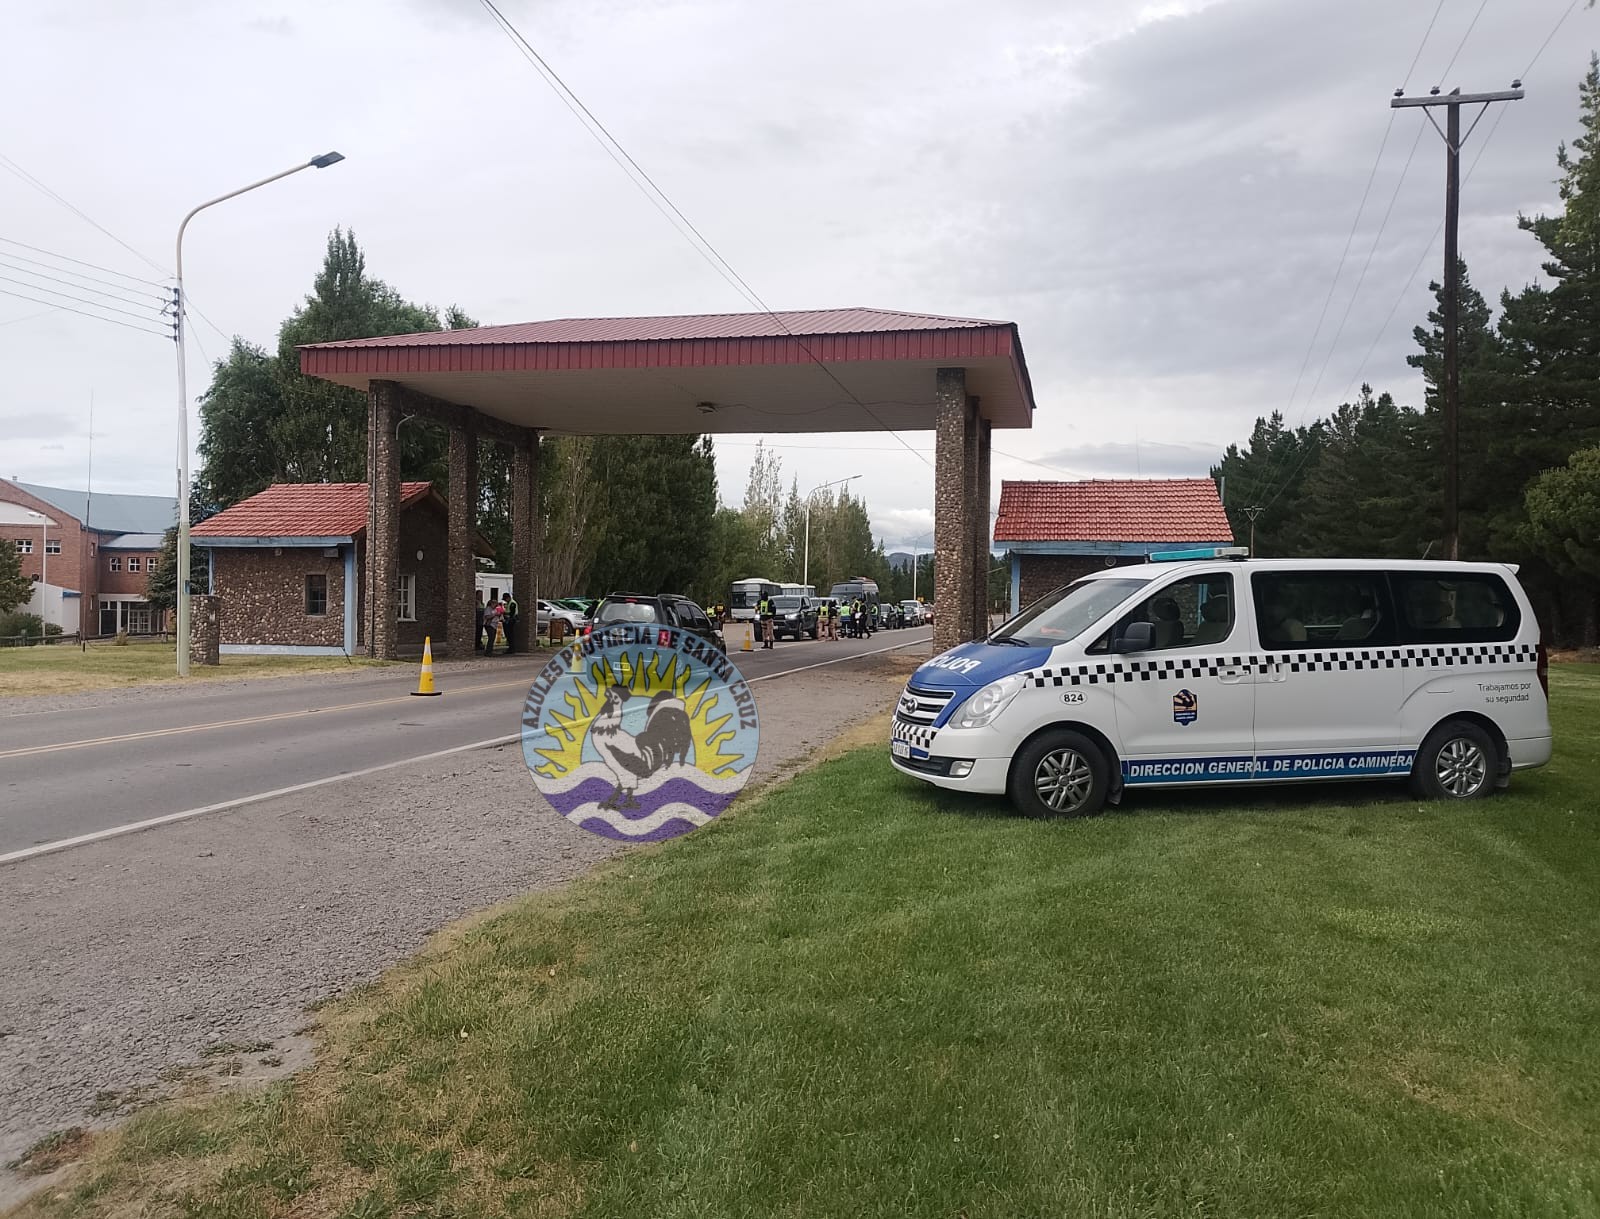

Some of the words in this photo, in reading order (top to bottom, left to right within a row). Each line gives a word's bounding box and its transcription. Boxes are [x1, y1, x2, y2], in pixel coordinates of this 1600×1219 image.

[1477, 683, 1519, 693] Trabajamos
[1520, 682, 1531, 691] por
[1063, 693, 1084, 703] 824
[1130, 762, 1205, 777] DIRECCION
[1208, 760, 1270, 774] GENERAL
[1273, 759, 1291, 772] DE
[1293, 757, 1345, 771] POLICIA
[1348, 754, 1413, 769] CAMINERA
